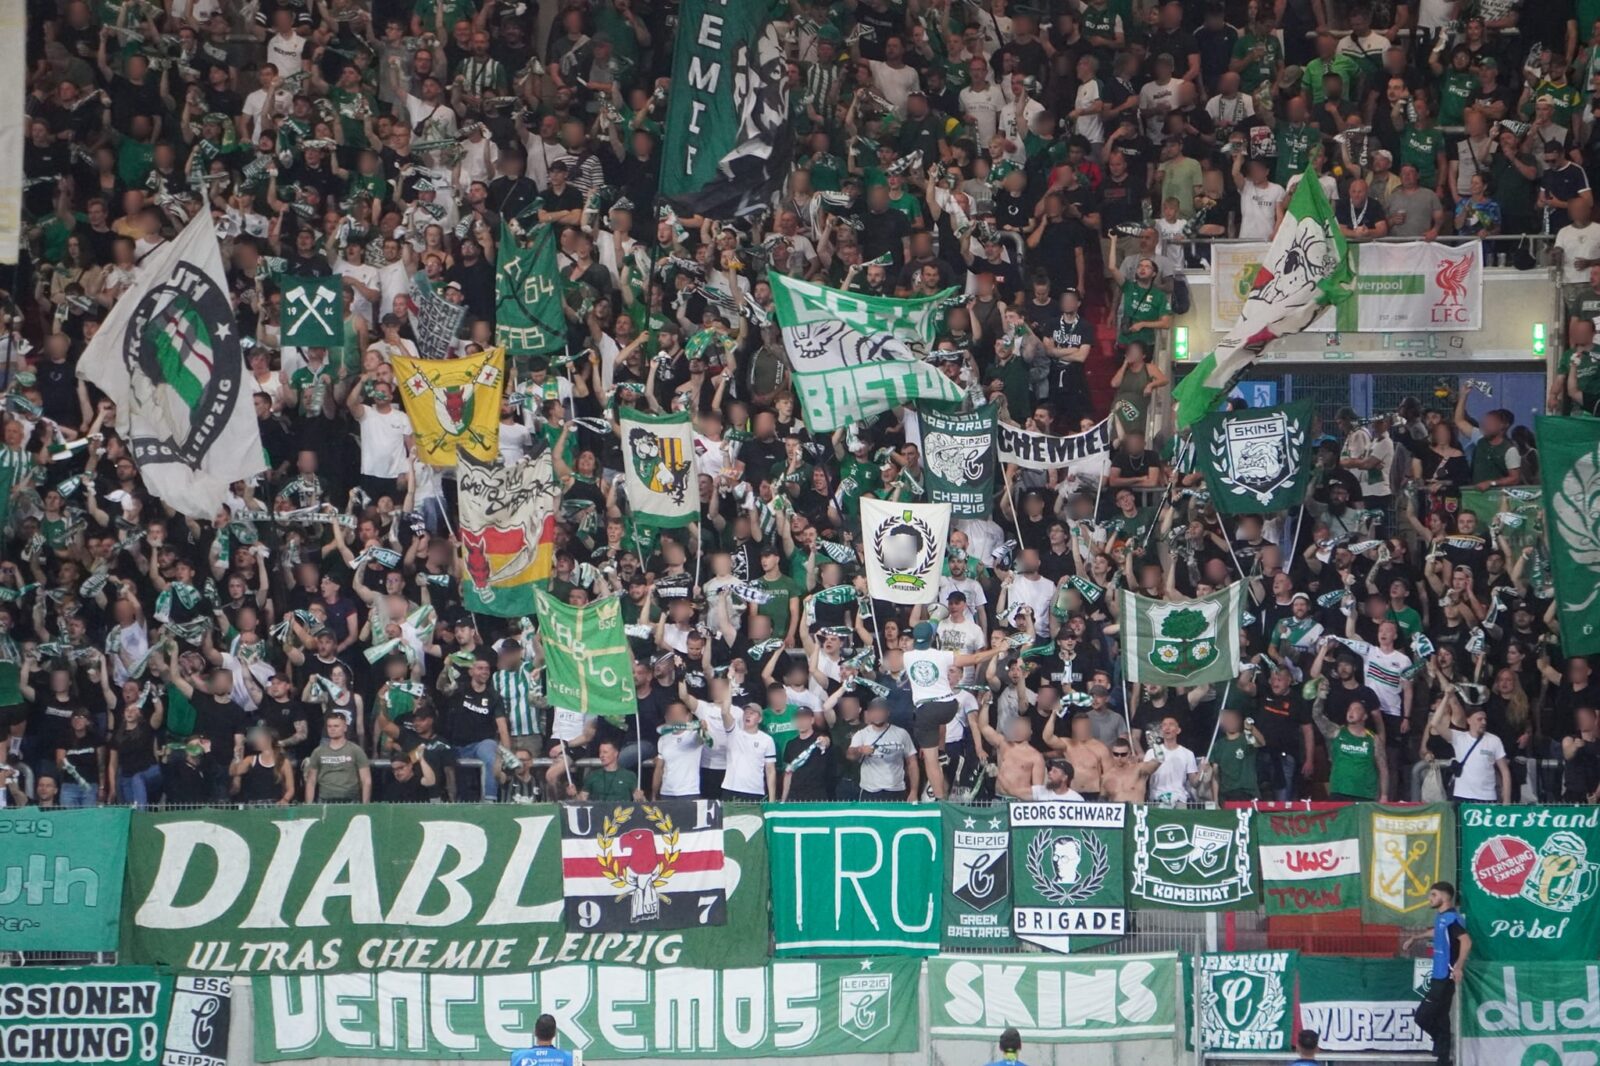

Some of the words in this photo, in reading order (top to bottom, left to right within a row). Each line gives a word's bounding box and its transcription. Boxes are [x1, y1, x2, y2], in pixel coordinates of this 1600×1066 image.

[1358, 280, 1403, 292] verpool
[287, 307, 297, 316] 19
[1234, 422, 1277, 437] SKINS
[135, 445, 173, 458] BSG
[1000, 423, 1112, 465] CHEMIE!
[1013, 805, 1056, 821] GEORG
[1059, 804, 1122, 822] SCHWARZ
[1270, 811, 1339, 837] RIOT
[957, 834, 1006, 846] LEIPZIG
[1198, 831, 1228, 841] LEIPZIG
[1286, 849, 1340, 873] UWE
[1478, 850, 1534, 880] STERNBURG
[773, 827, 937, 933] TRC
[1153, 884, 1230, 901] KOMBINAT
[960, 915, 998, 925] GREEN
[1018, 911, 1121, 930] BRIGADE
[1489, 917, 1570, 939] Pöbel
[948, 925, 1010, 938] BASTARDS
[186, 939, 341, 972] ULTRAS
[357, 938, 519, 970] CHEMIE
[528, 933, 684, 964] LEIPZIG
[193, 979, 231, 994] BSG
[843, 980, 887, 989] LEIPZIG
[0, 985, 156, 1016] SSIONEN
[944, 961, 1158, 1028] SKINS
